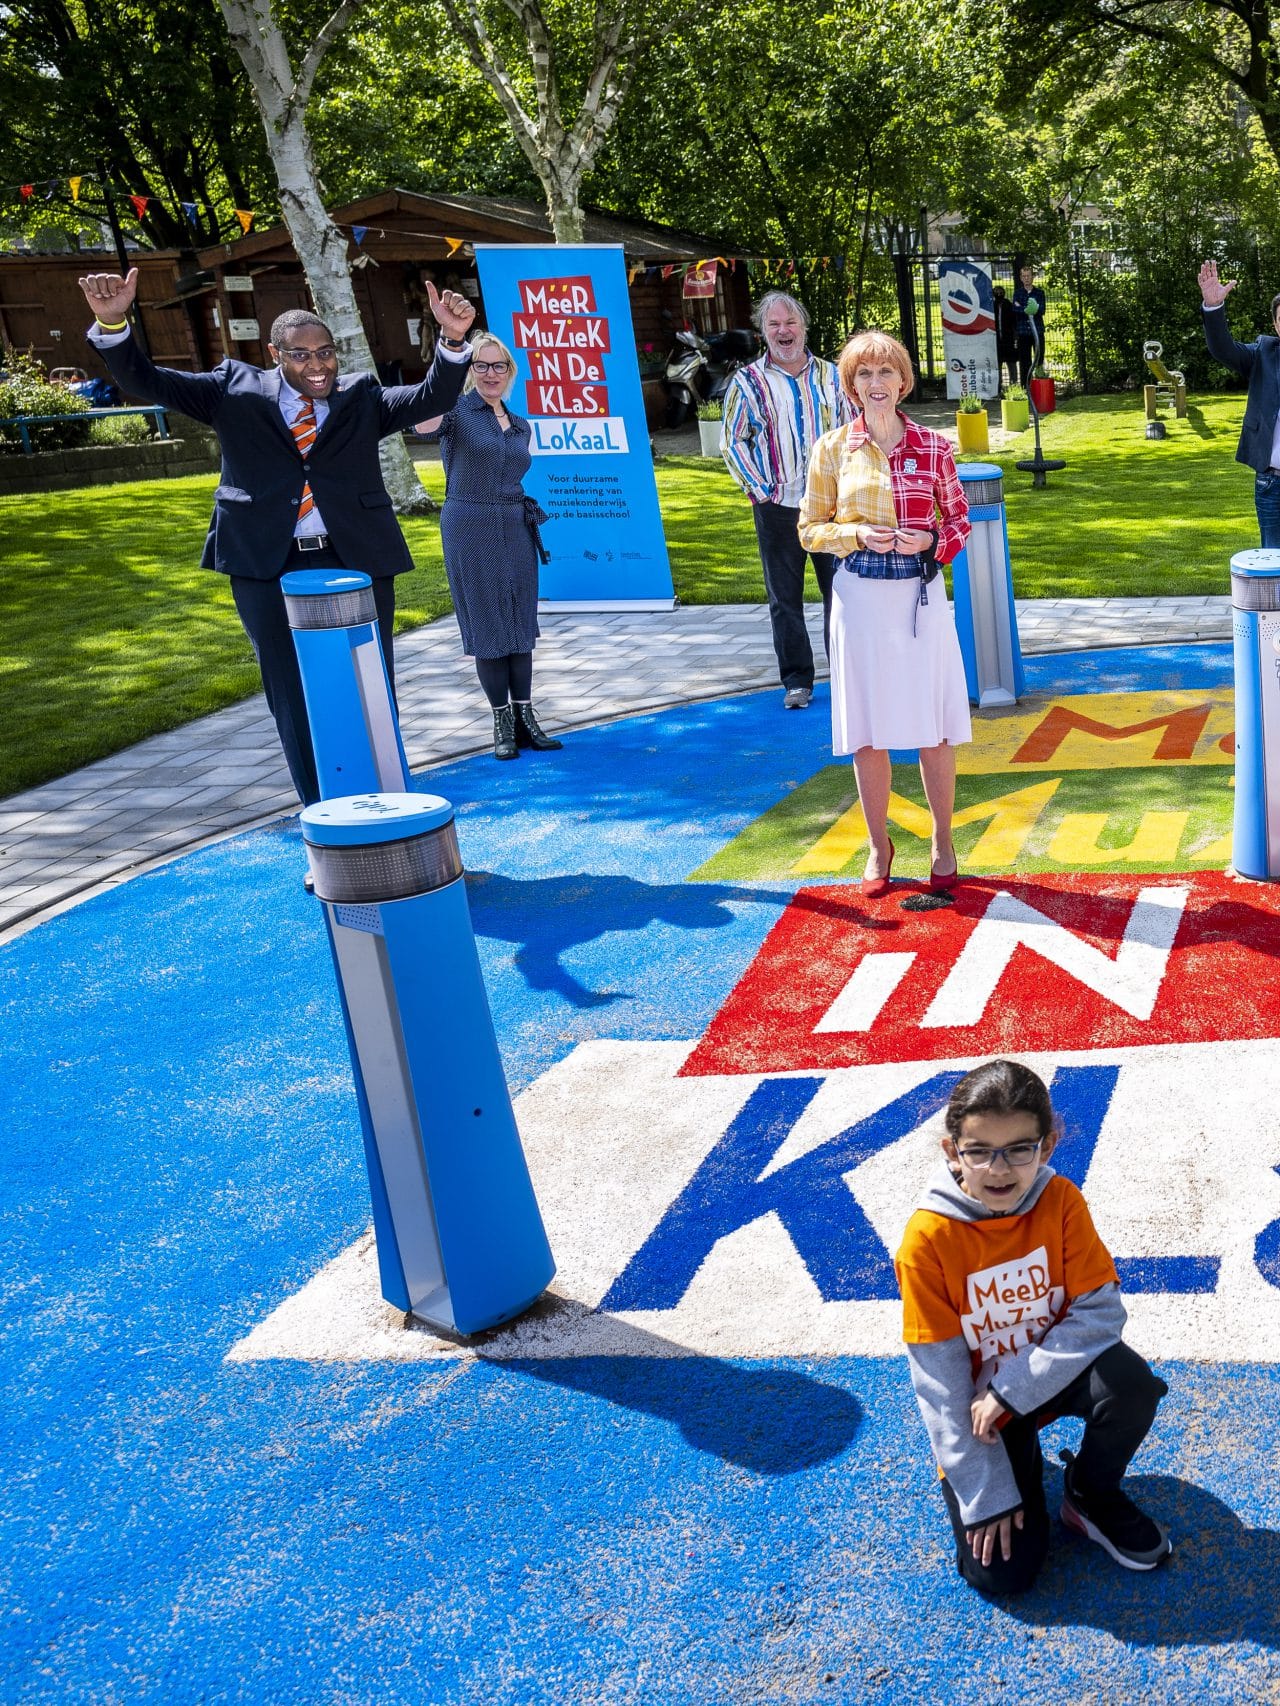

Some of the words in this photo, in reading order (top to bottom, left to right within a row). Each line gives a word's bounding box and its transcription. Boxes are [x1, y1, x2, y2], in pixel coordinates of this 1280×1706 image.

[519, 319, 606, 348] MuZieK
[535, 352, 561, 381] iN
[566, 352, 600, 381] De
[534, 421, 620, 450] LoKaaL
[548, 474, 570, 483] Voor
[572, 474, 619, 483] duurzame
[548, 486, 604, 496] verankering
[548, 498, 627, 508] muziekonderwijs
[563, 510, 574, 518] de
[577, 509, 630, 519] basisschool
[811, 886, 1190, 1034] iN
